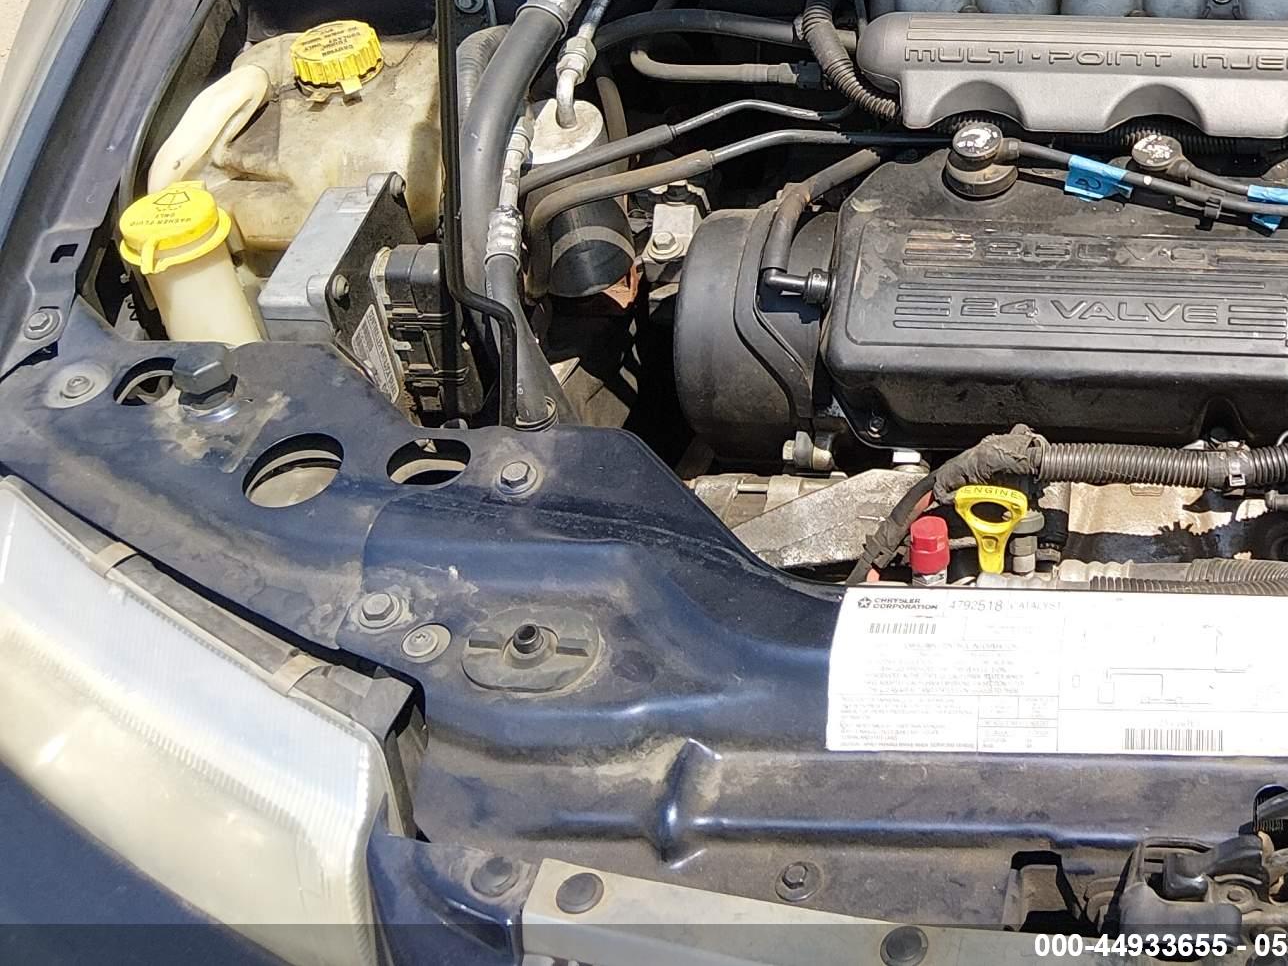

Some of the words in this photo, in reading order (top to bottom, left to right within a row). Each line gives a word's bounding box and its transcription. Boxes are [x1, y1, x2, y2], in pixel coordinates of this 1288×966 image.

[961, 297, 1038, 319] 24
[1050, 299, 1220, 323] VALVE
[958, 486, 1018, 498] ENGINE
